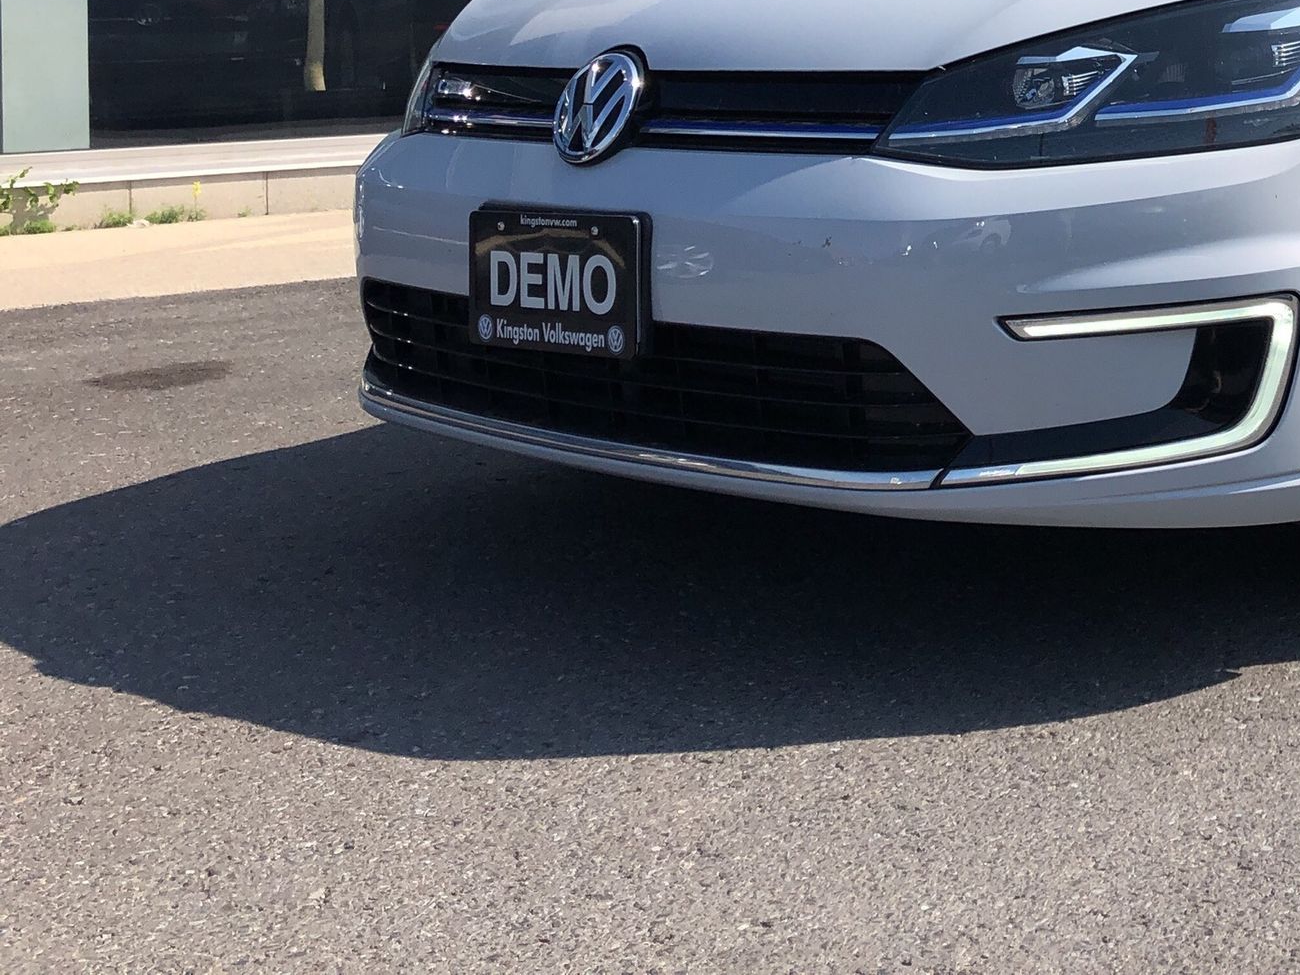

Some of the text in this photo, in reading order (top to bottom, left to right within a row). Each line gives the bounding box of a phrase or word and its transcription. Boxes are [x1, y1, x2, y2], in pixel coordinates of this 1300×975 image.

[519, 213, 578, 228] kingstonvw.com
[489, 250, 617, 316] DEMO
[496, 318, 605, 352] Kingston Volkswagen
